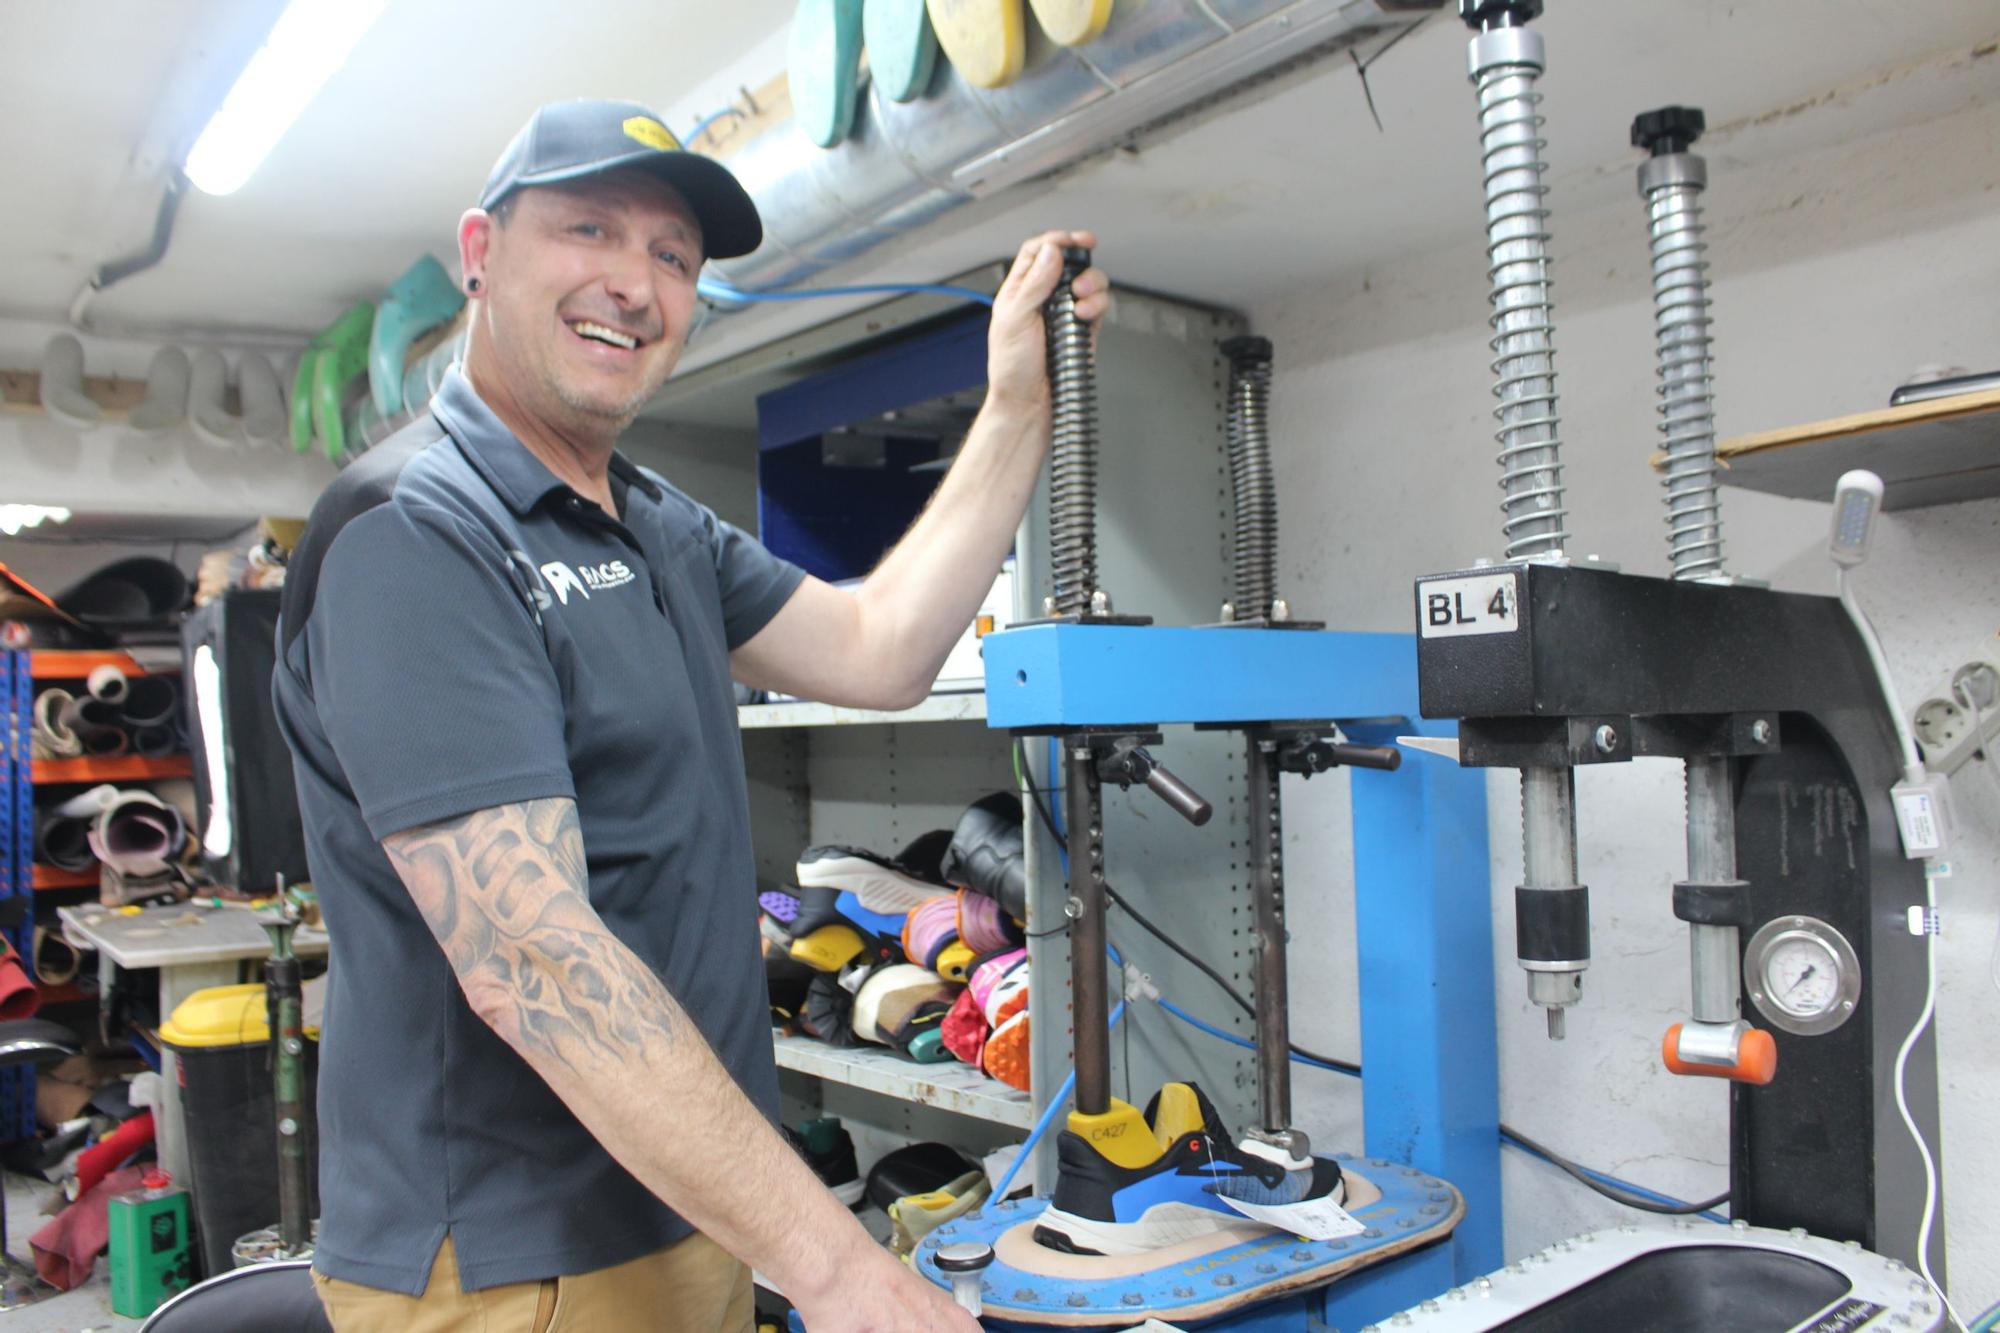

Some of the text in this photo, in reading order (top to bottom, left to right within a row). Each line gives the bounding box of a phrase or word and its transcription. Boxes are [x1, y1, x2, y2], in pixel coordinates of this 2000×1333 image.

[1429, 587, 1508, 626] BL 4
[1091, 1122, 1128, 1142] C427
